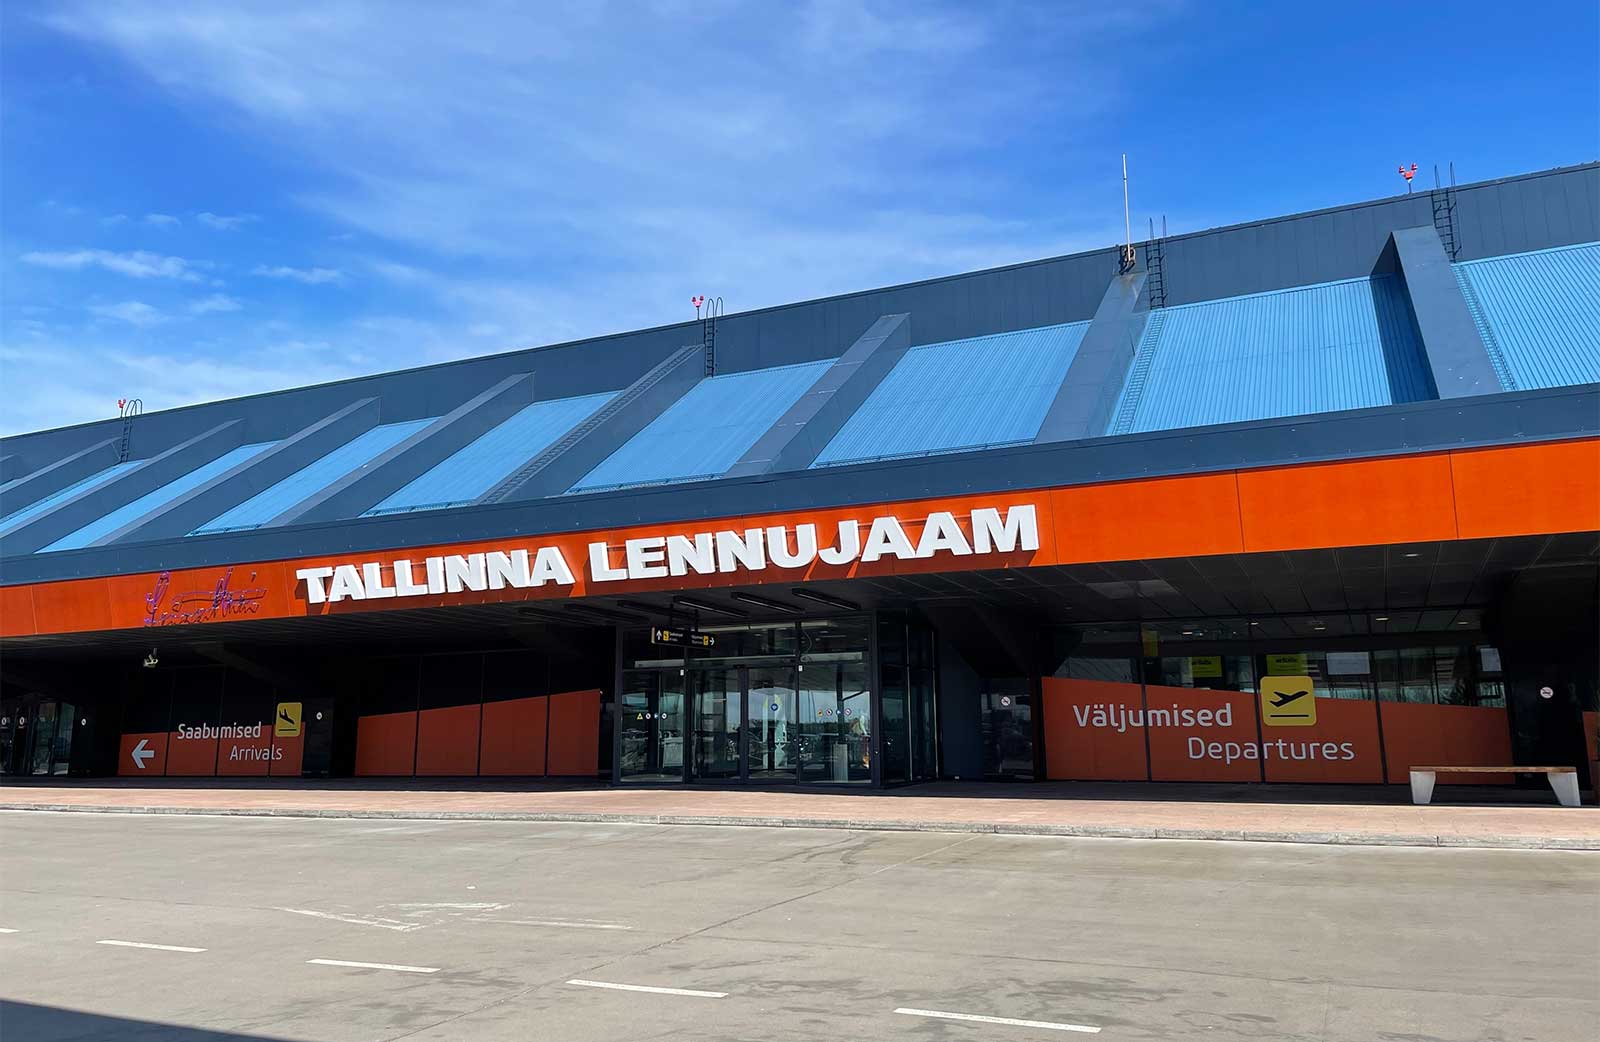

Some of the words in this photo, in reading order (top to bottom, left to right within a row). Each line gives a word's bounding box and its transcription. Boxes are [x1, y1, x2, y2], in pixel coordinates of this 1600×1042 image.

[296, 546, 576, 604] TALLINNA
[588, 504, 1039, 582] LENNUJAAM
[177, 721, 262, 739] Saabumised
[1072, 703, 1233, 733] Väljumised
[229, 744, 283, 761] Arrivals
[1188, 736, 1355, 764] Departures
